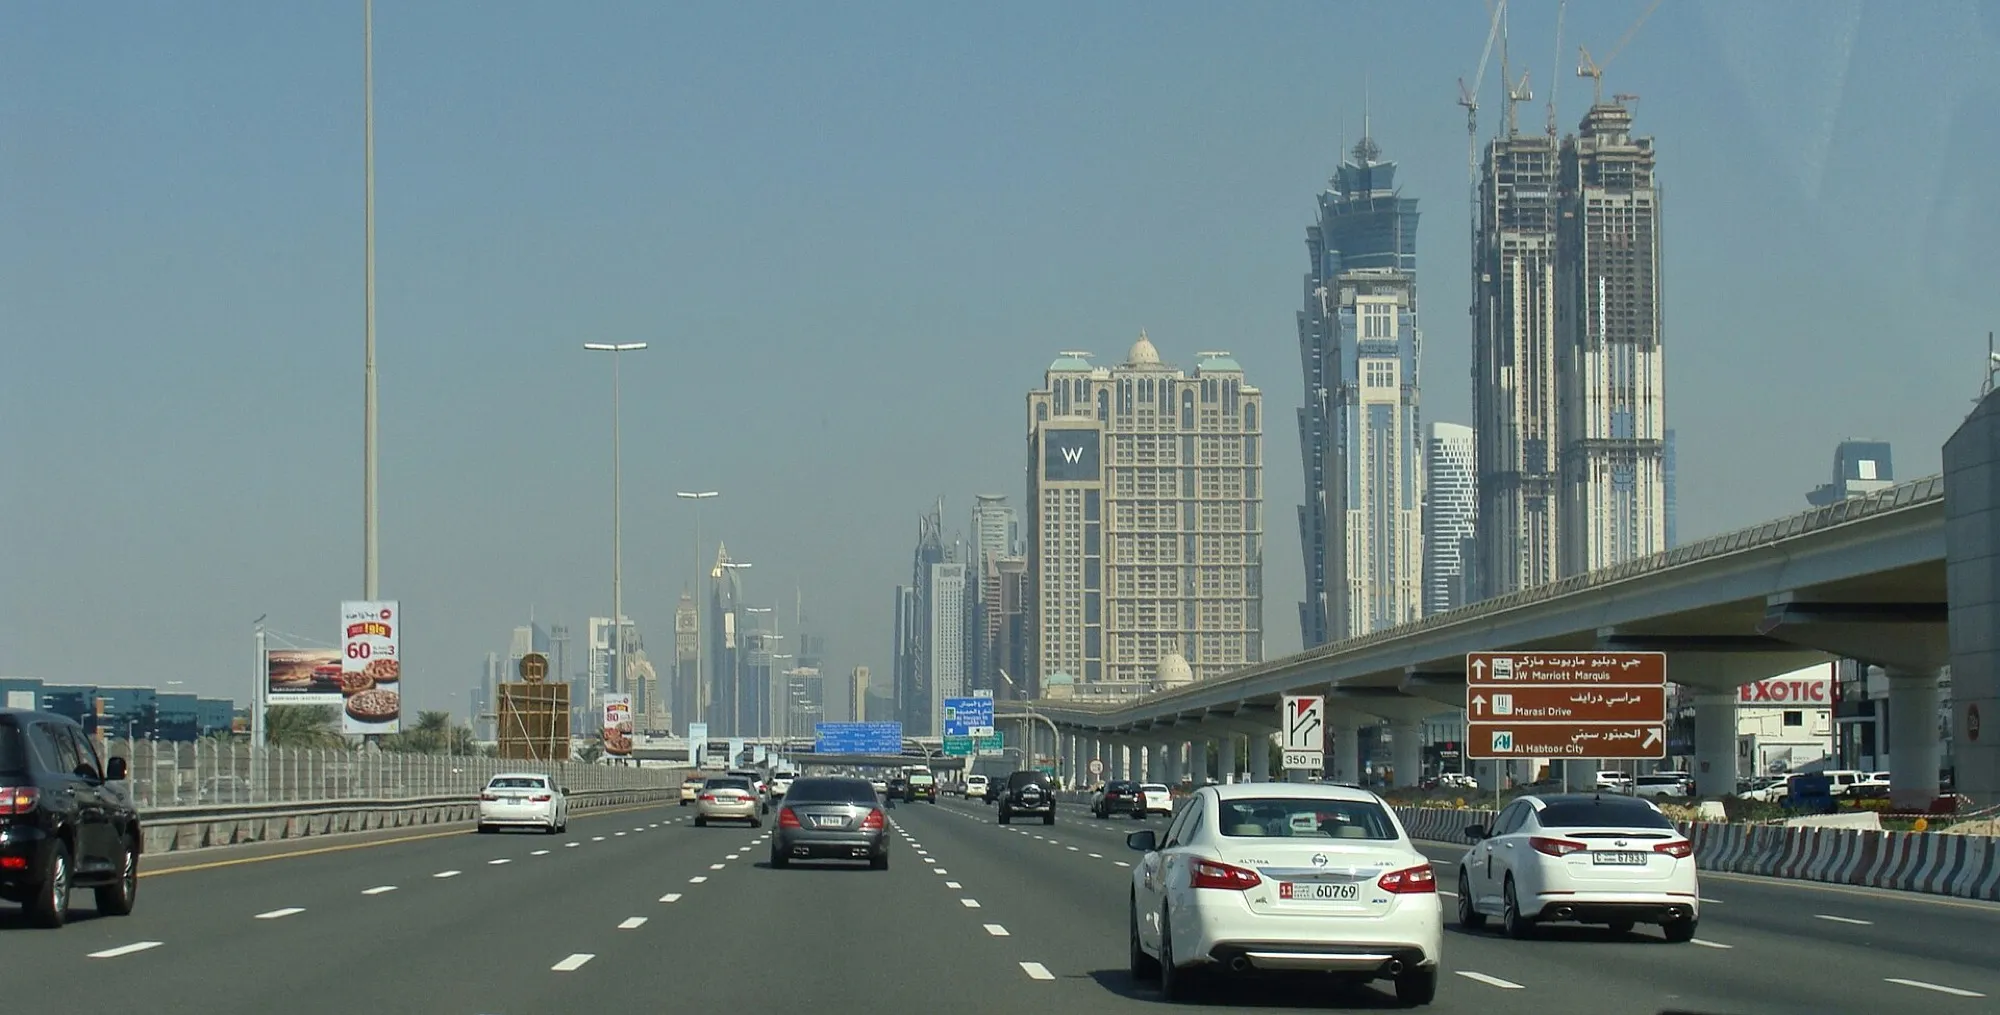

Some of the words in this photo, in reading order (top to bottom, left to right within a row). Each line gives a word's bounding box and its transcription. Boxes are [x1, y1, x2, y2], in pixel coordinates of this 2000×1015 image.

[1061, 447, 1083, 464] W
[347, 642, 371, 659] 60
[1514, 671, 1528, 681] JW
[1532, 671, 1571, 681] Marriott
[1575, 671, 1611, 682] Marquis
[1741, 681, 1824, 701] EXOTIC
[1569, 692, 1604, 704] درايف
[1605, 692, 1641, 707] مراسي
[1514, 707, 1546, 717] Marasi
[1548, 707, 1573, 717] Drive
[1602, 728, 1641, 741] الحبتور
[1514, 745, 1525, 754] Al
[1526, 745, 1563, 754] Habtoor
[1565, 745, 1584, 755] City
[1285, 755, 1307, 765] 350
[1311, 757, 1321, 765] m
[1316, 885, 1357, 899] 60769
